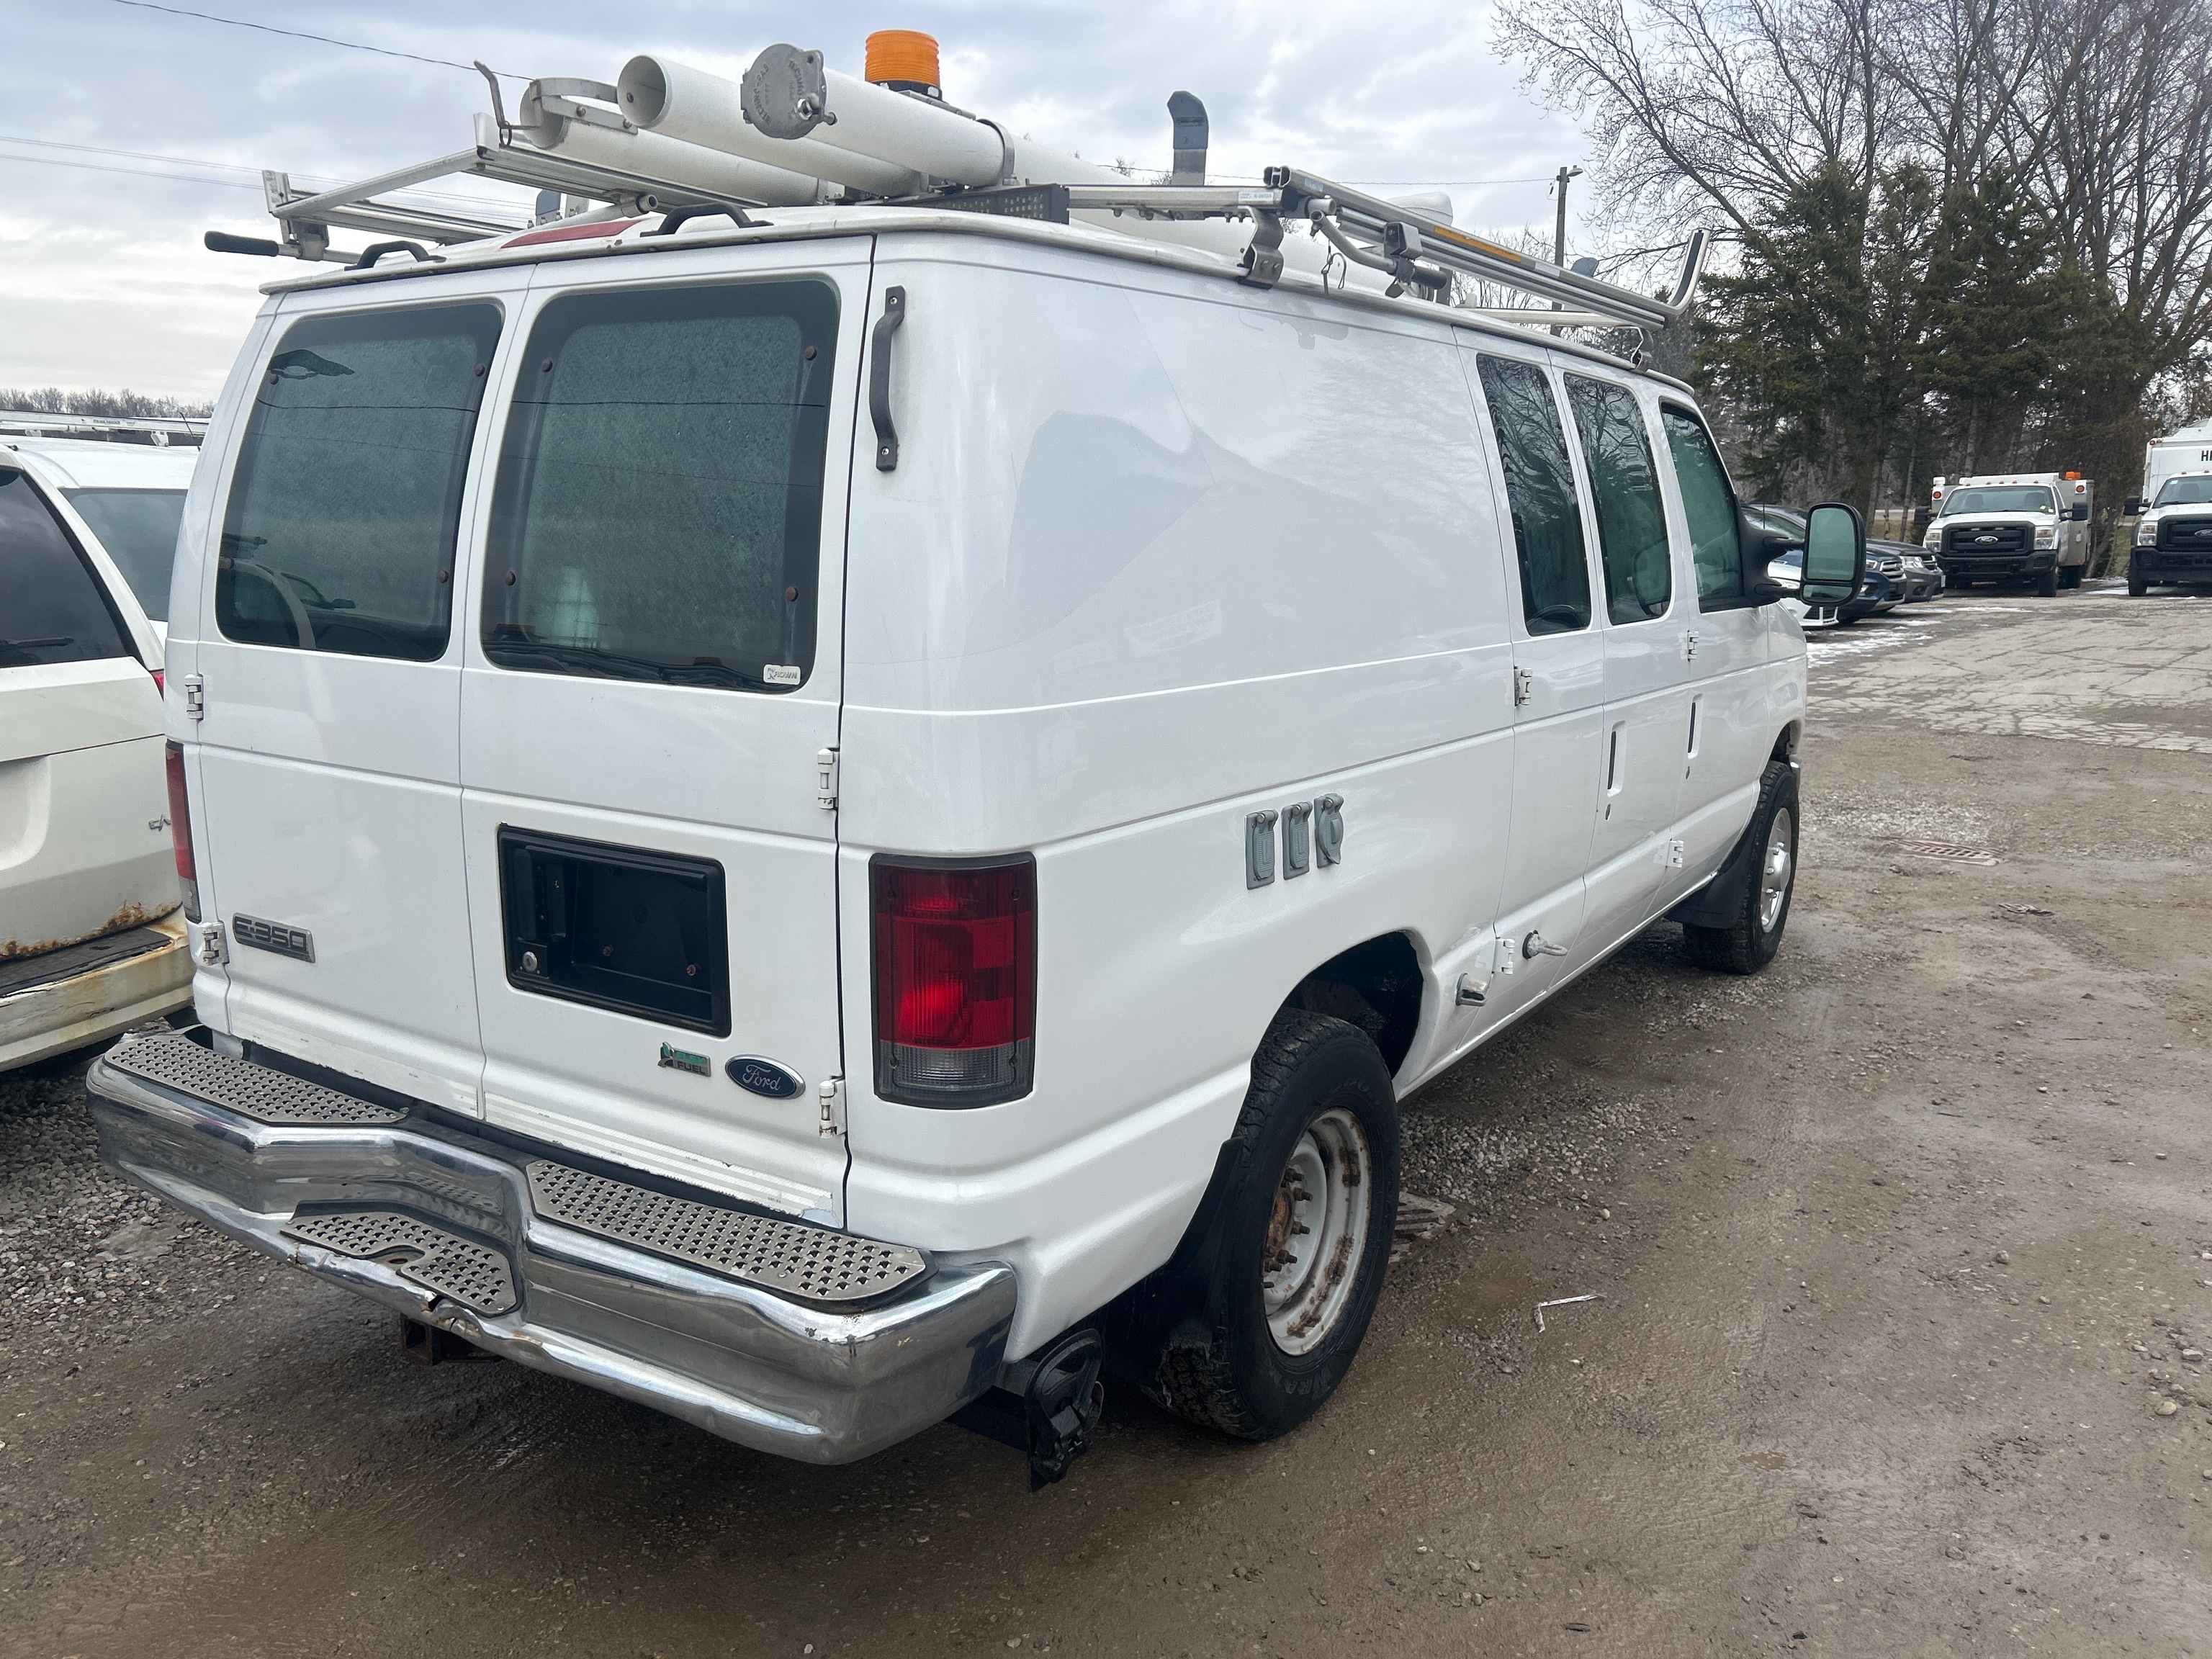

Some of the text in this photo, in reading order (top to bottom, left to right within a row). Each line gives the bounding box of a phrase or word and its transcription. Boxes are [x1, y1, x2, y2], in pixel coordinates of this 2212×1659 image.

[676, 1052, 706, 1065] FLEX
[677, 1061, 706, 1075] FUEL
[742, 1064, 782, 1092] Ford
